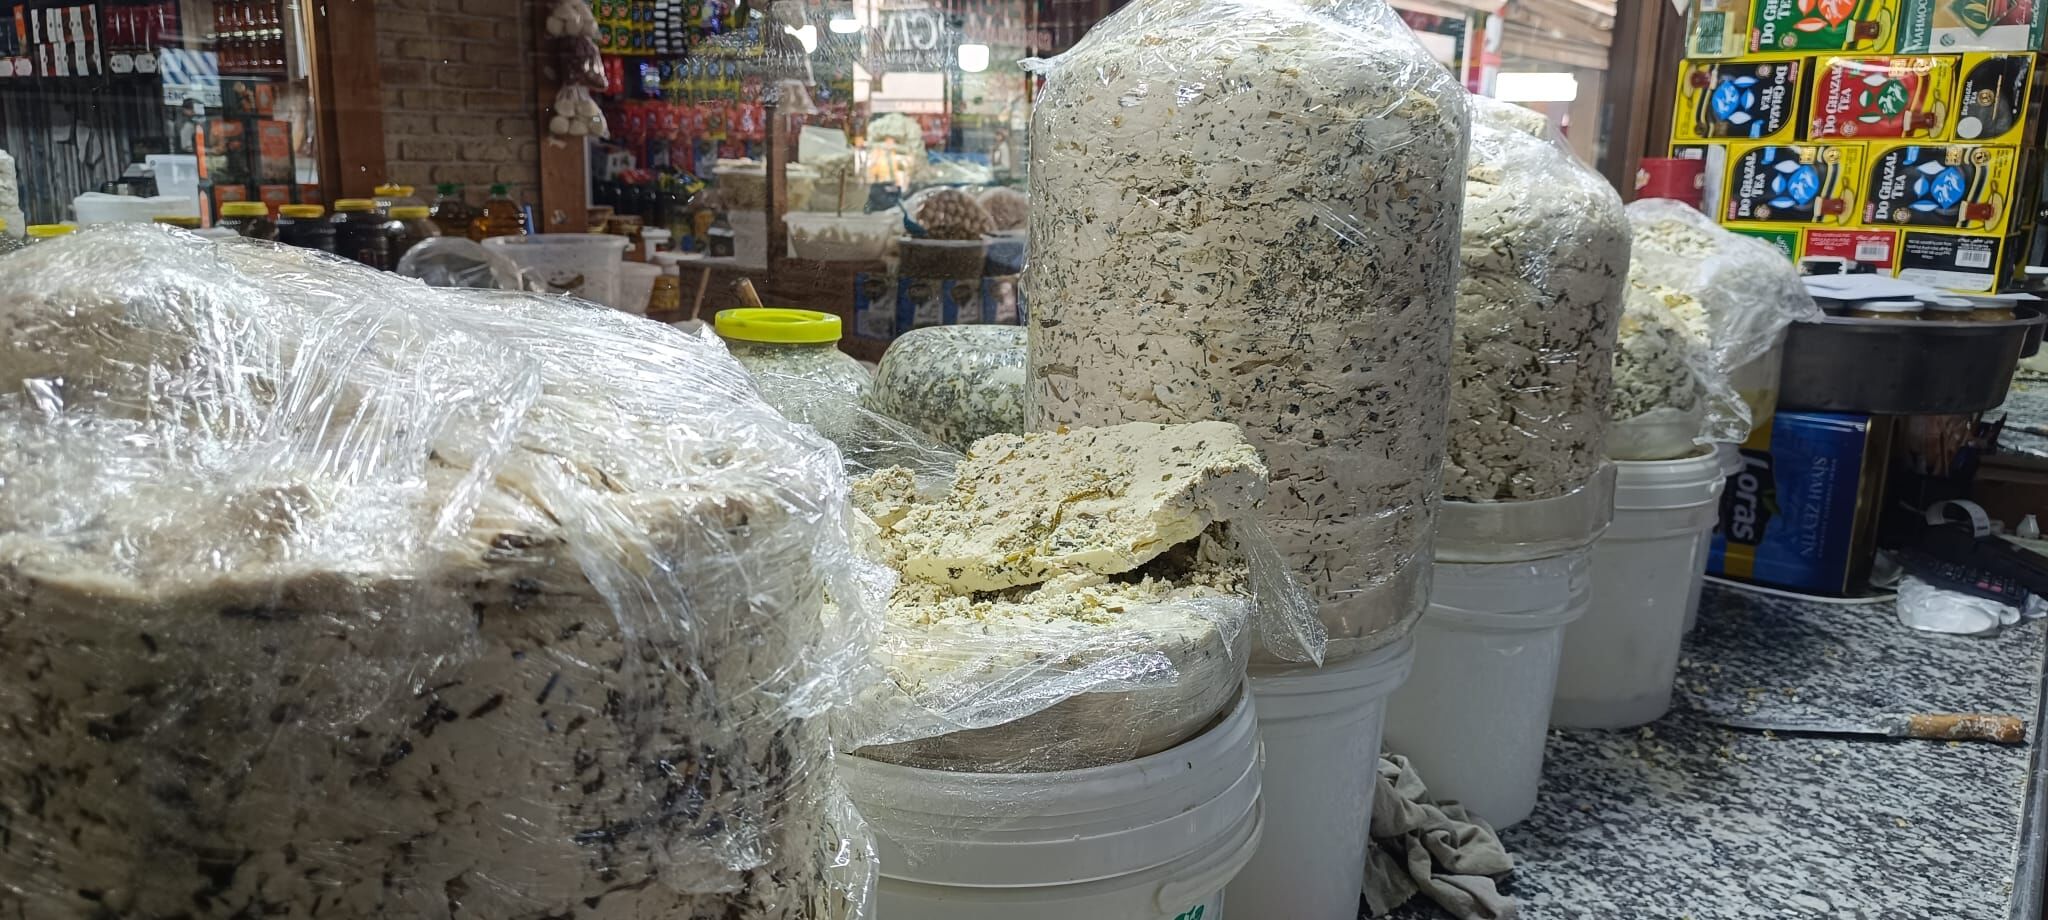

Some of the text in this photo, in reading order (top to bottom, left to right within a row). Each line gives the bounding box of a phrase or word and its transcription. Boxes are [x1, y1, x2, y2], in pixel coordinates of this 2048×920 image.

[1760, 86, 1774, 111] TEA
[1768, 85, 1786, 132] GHAZAL
[1838, 87, 1852, 113] TEA
[1740, 151, 1757, 198] GHAZAL
[1751, 172, 1766, 198] TEA
[1878, 152, 1898, 200] GHAZAL
[1891, 174, 1907, 200] TEA
[1732, 456, 1769, 540] Loras
